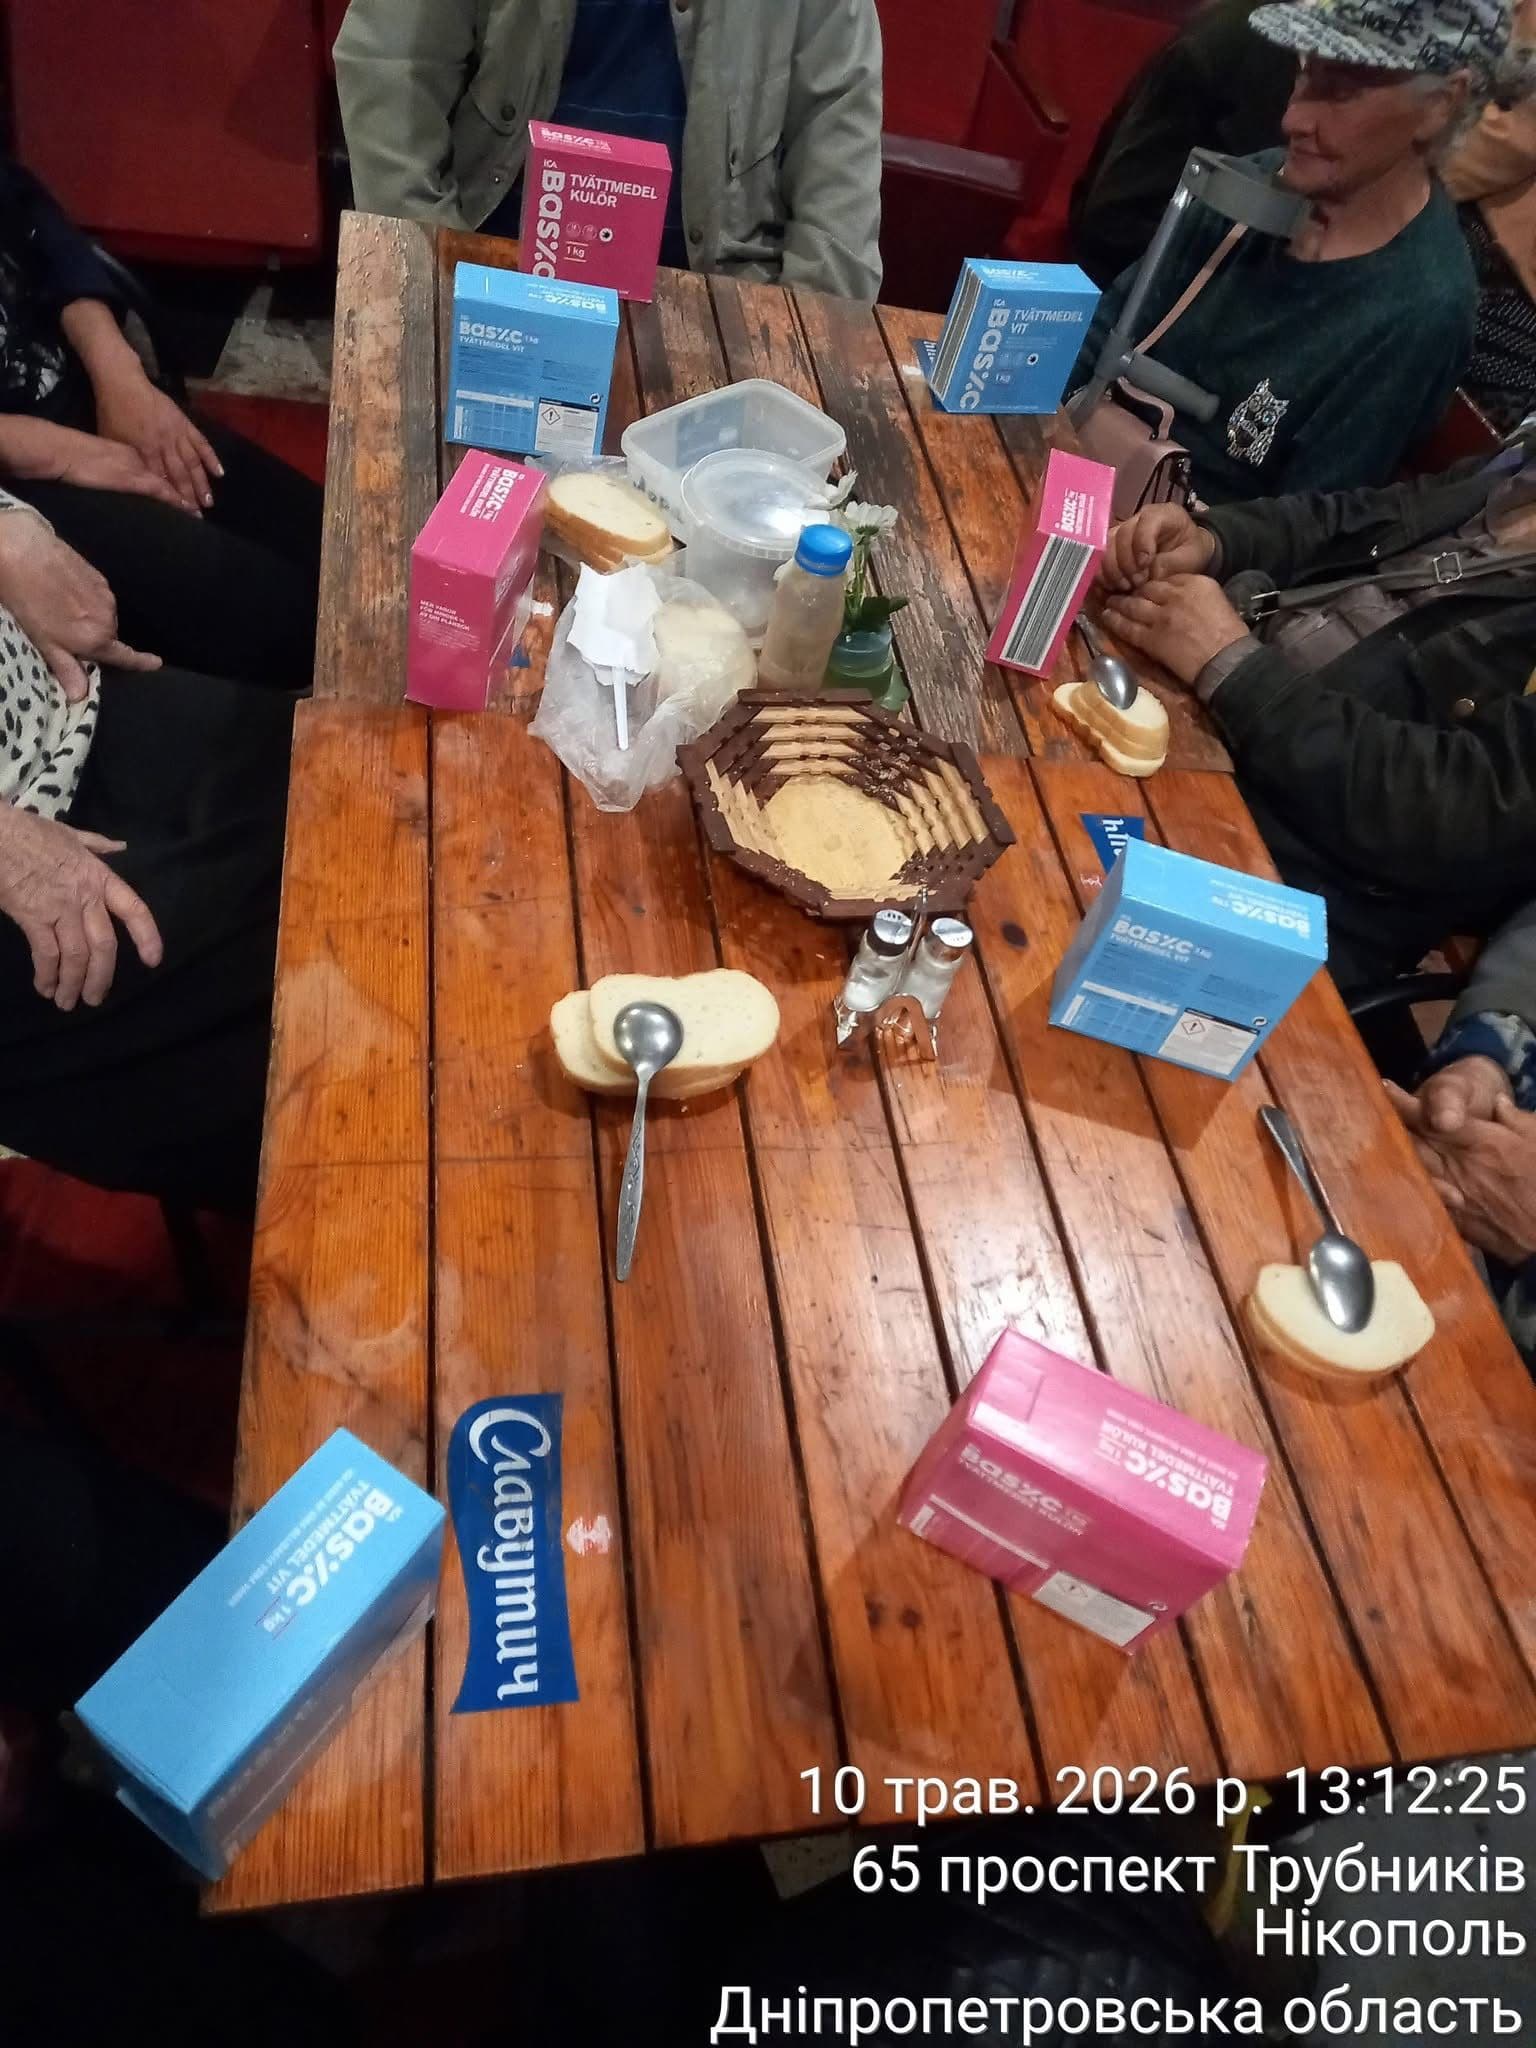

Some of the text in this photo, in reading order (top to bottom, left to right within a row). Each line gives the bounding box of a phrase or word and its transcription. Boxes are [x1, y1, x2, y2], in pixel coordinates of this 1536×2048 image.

[570, 173, 658, 201] TVÄTTMEDEL
[570, 191, 618, 208] KULÖR
[573, 247, 586, 259] kg
[1014, 307, 1083, 322] TVÄTTMEDEL
[1011, 322, 1029, 335] VIT
[468, 1407, 552, 1702] Славутич
[265, 1568, 292, 1595] VIT
